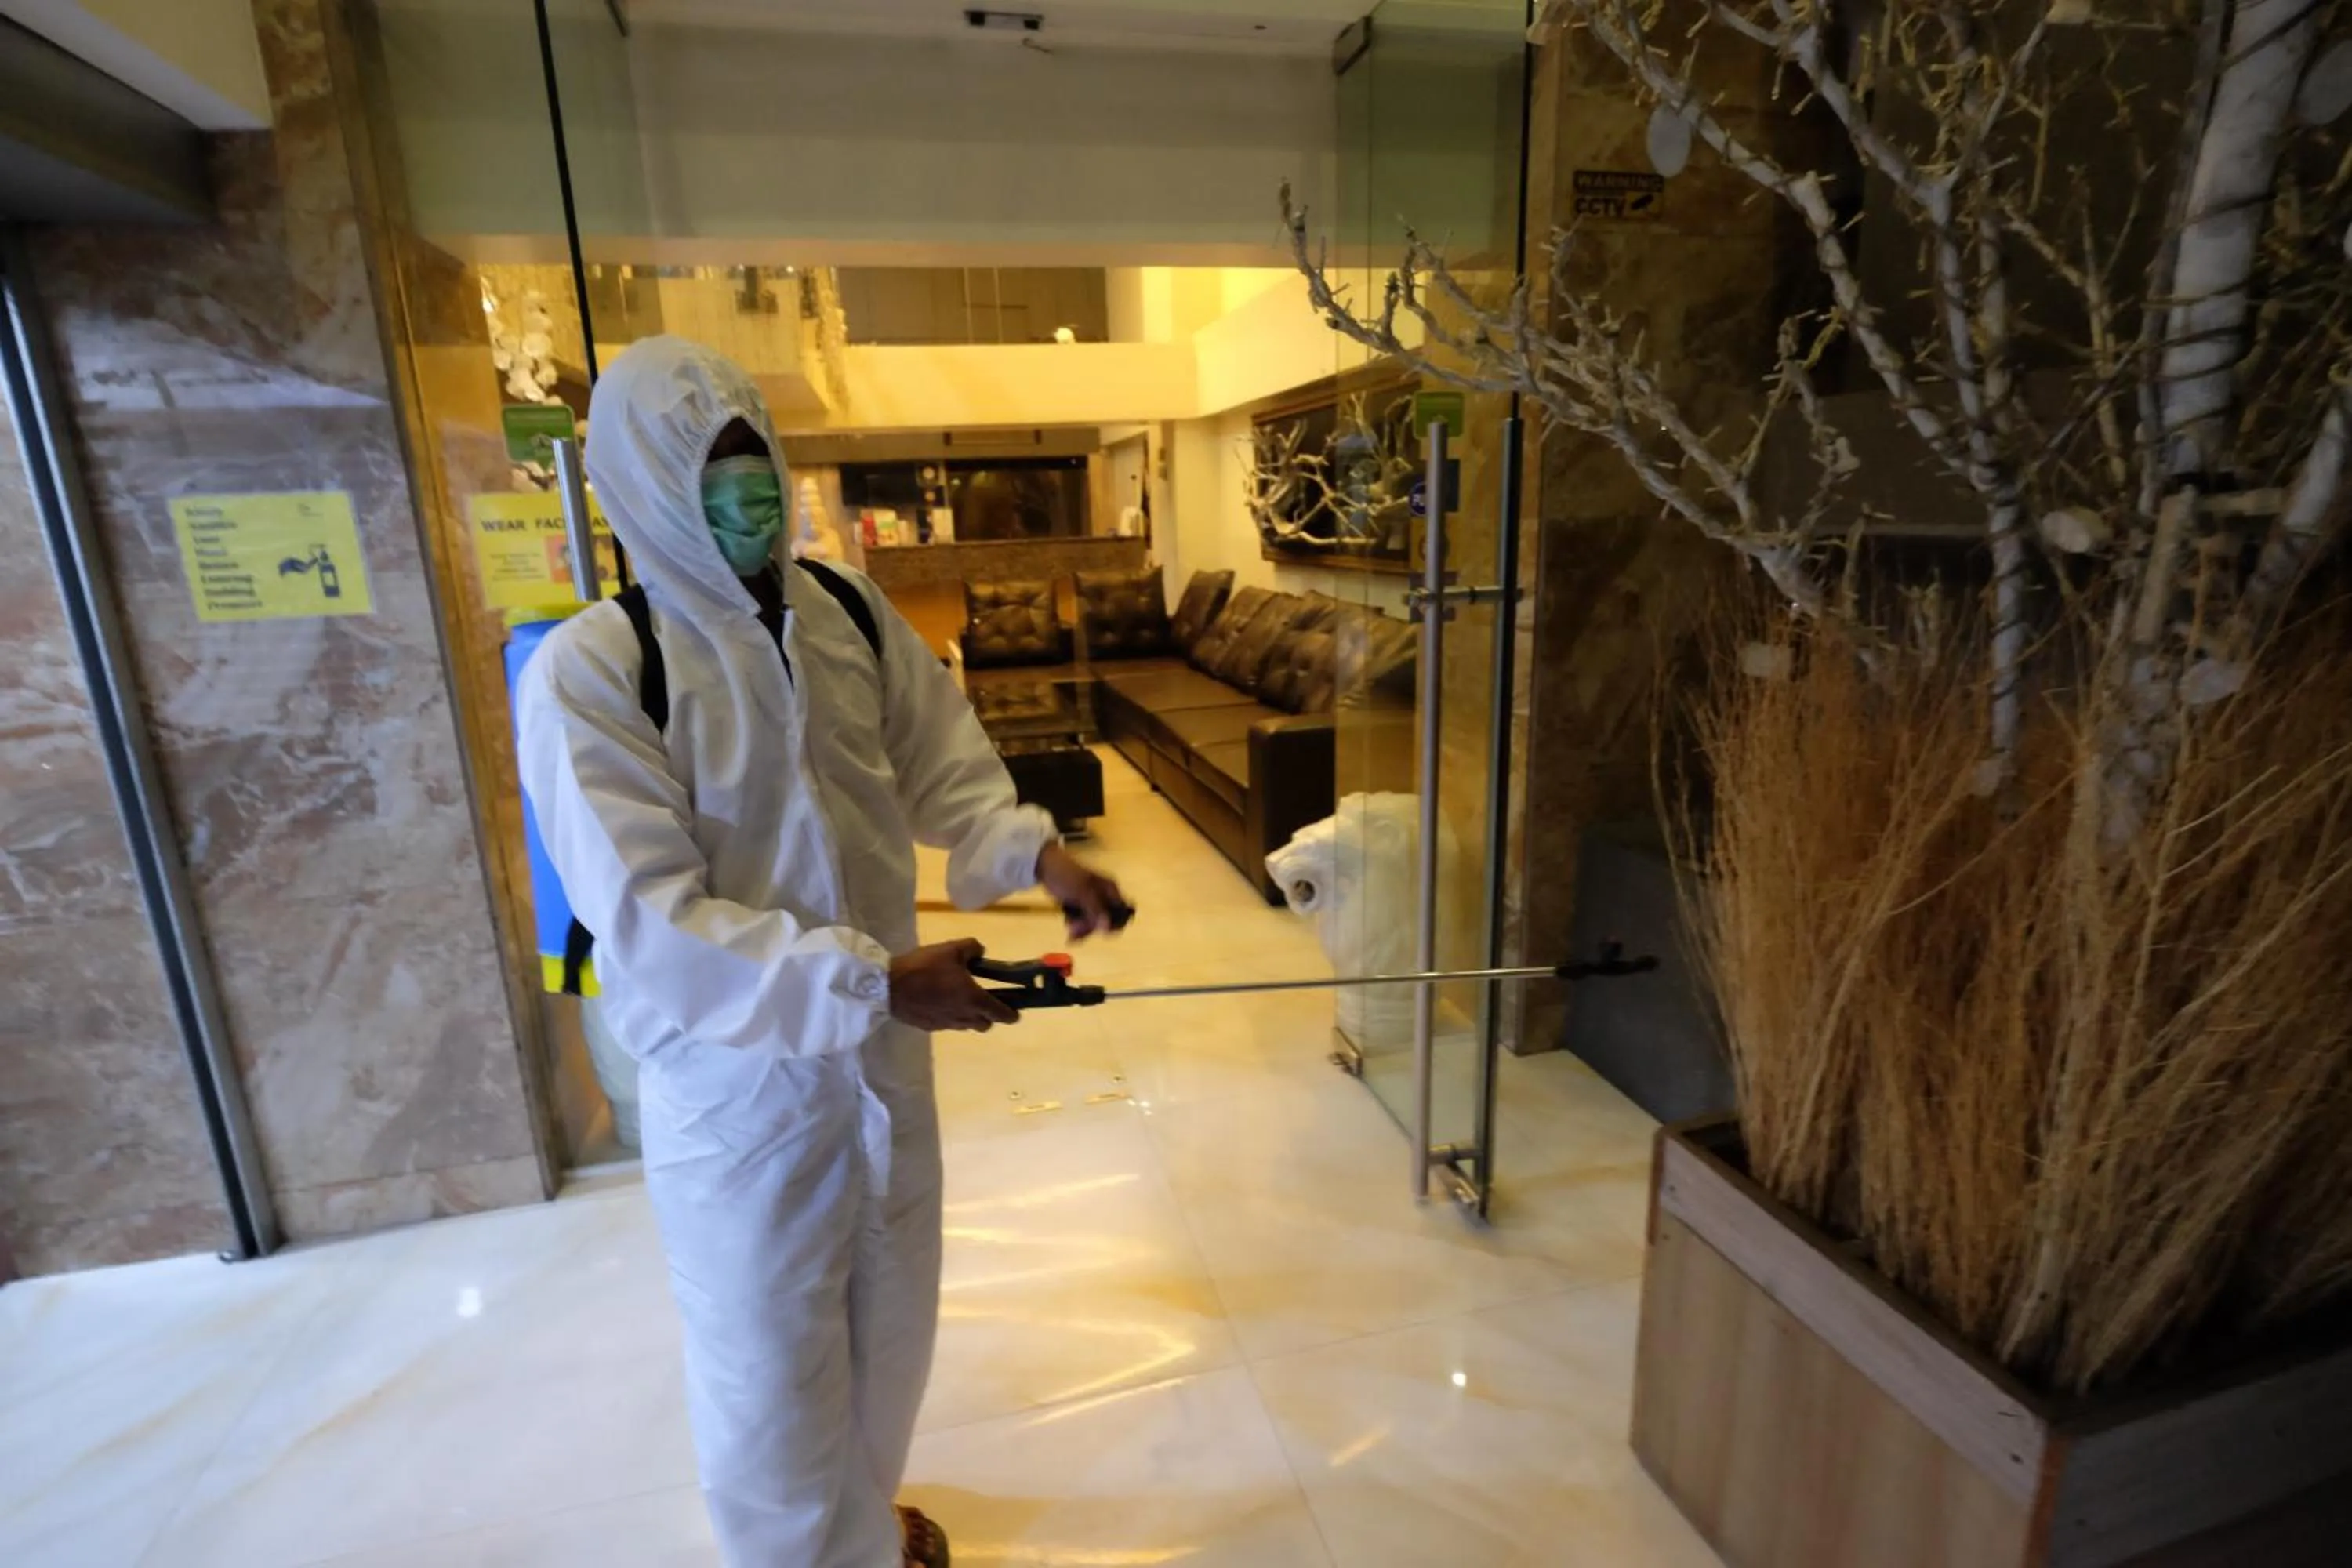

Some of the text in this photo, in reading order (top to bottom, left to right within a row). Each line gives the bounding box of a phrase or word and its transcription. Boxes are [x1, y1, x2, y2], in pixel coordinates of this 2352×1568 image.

[1575, 198, 1626, 216] CCTV
[481, 518, 526, 532] WEAR
[535, 517, 566, 529] FAC
